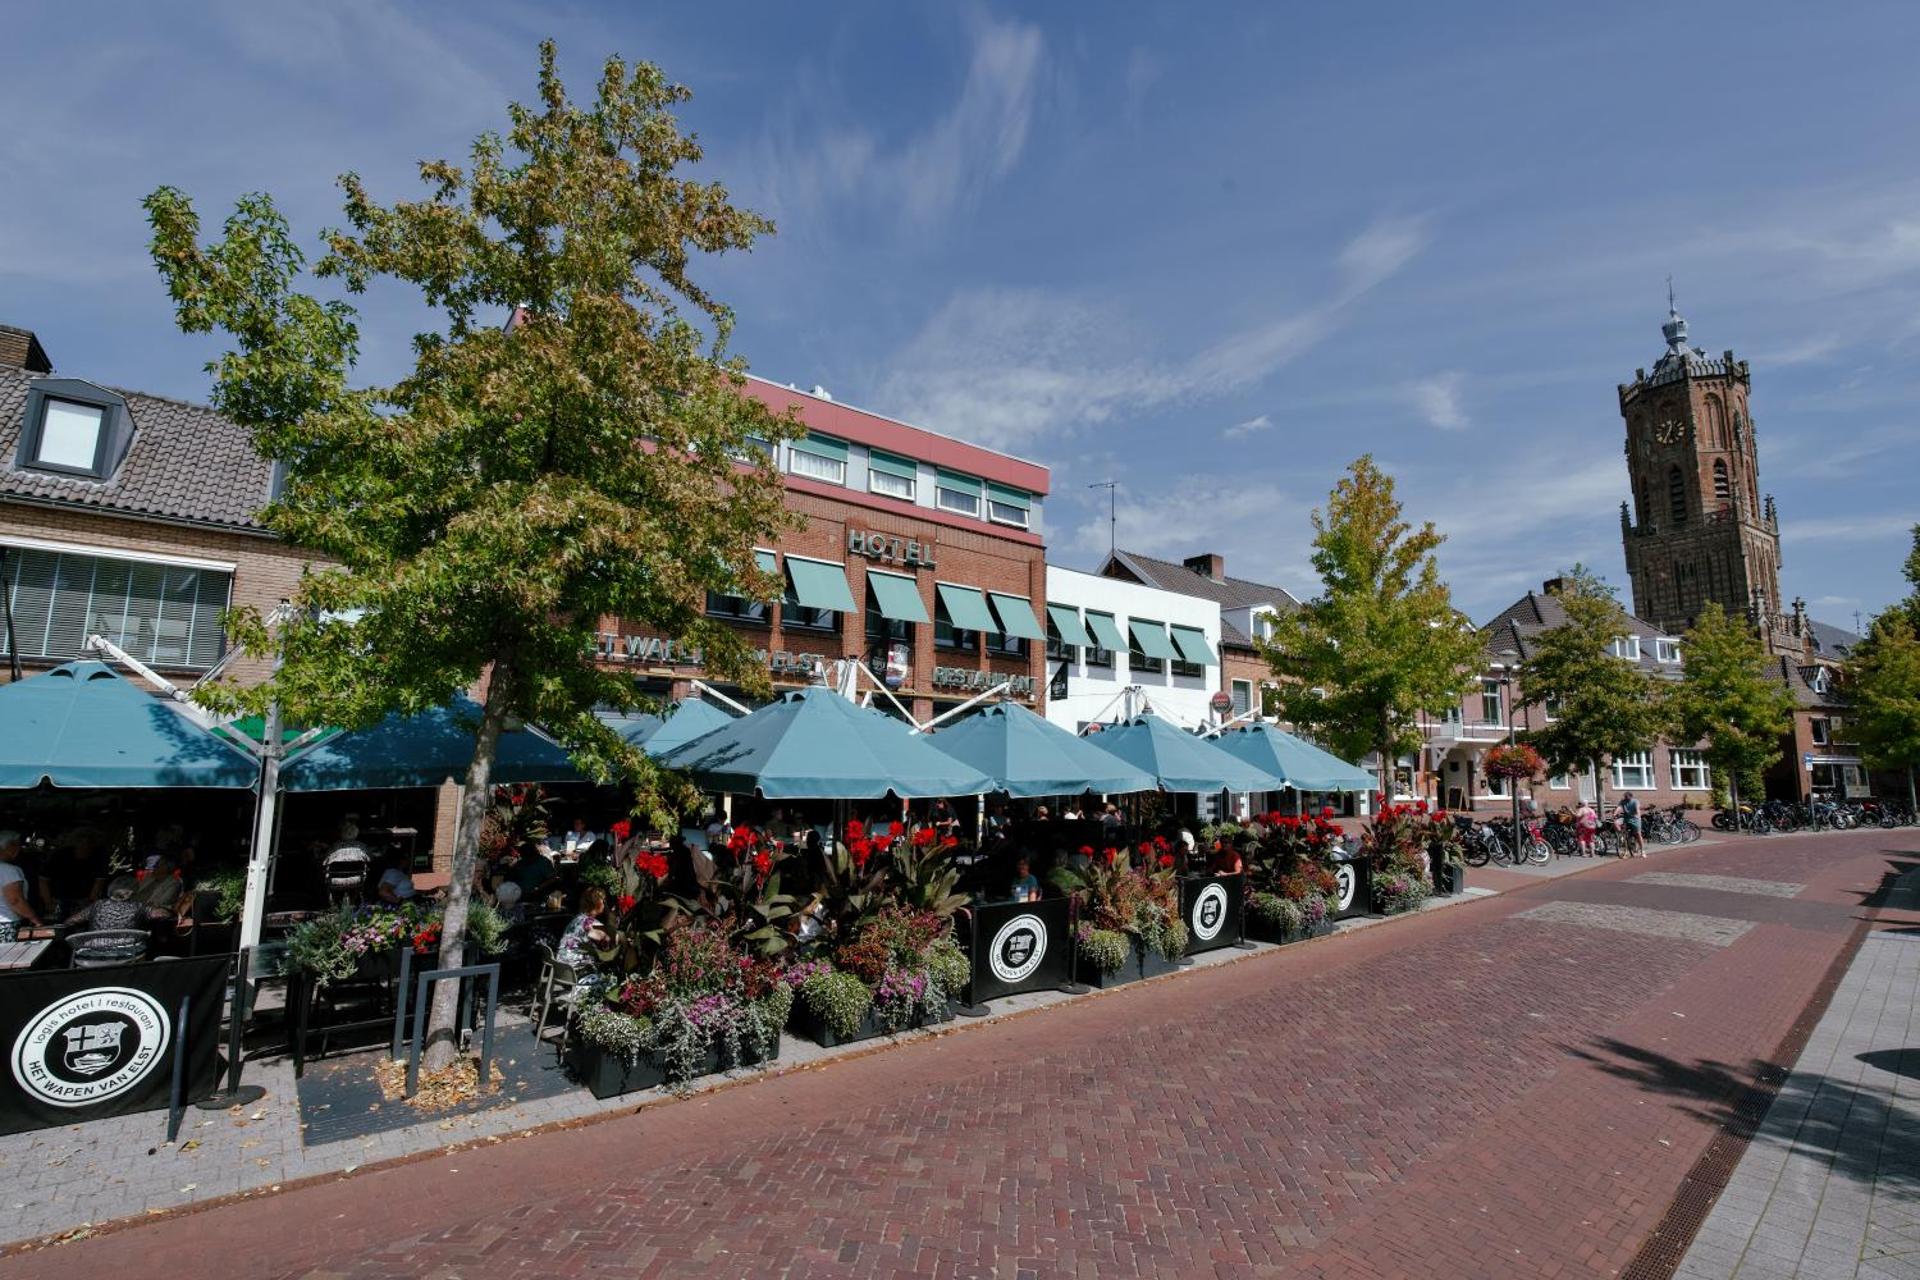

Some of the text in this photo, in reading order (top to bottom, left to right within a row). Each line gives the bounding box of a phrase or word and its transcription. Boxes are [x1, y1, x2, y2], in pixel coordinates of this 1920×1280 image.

[848, 529, 938, 567] HOTEL
[33, 1020, 59, 1044] logis
[59, 1000, 94, 1019] hotel
[106, 999, 154, 1030] restaurant
[29, 1046, 152, 1096] HET WAPEN VAN ELST
